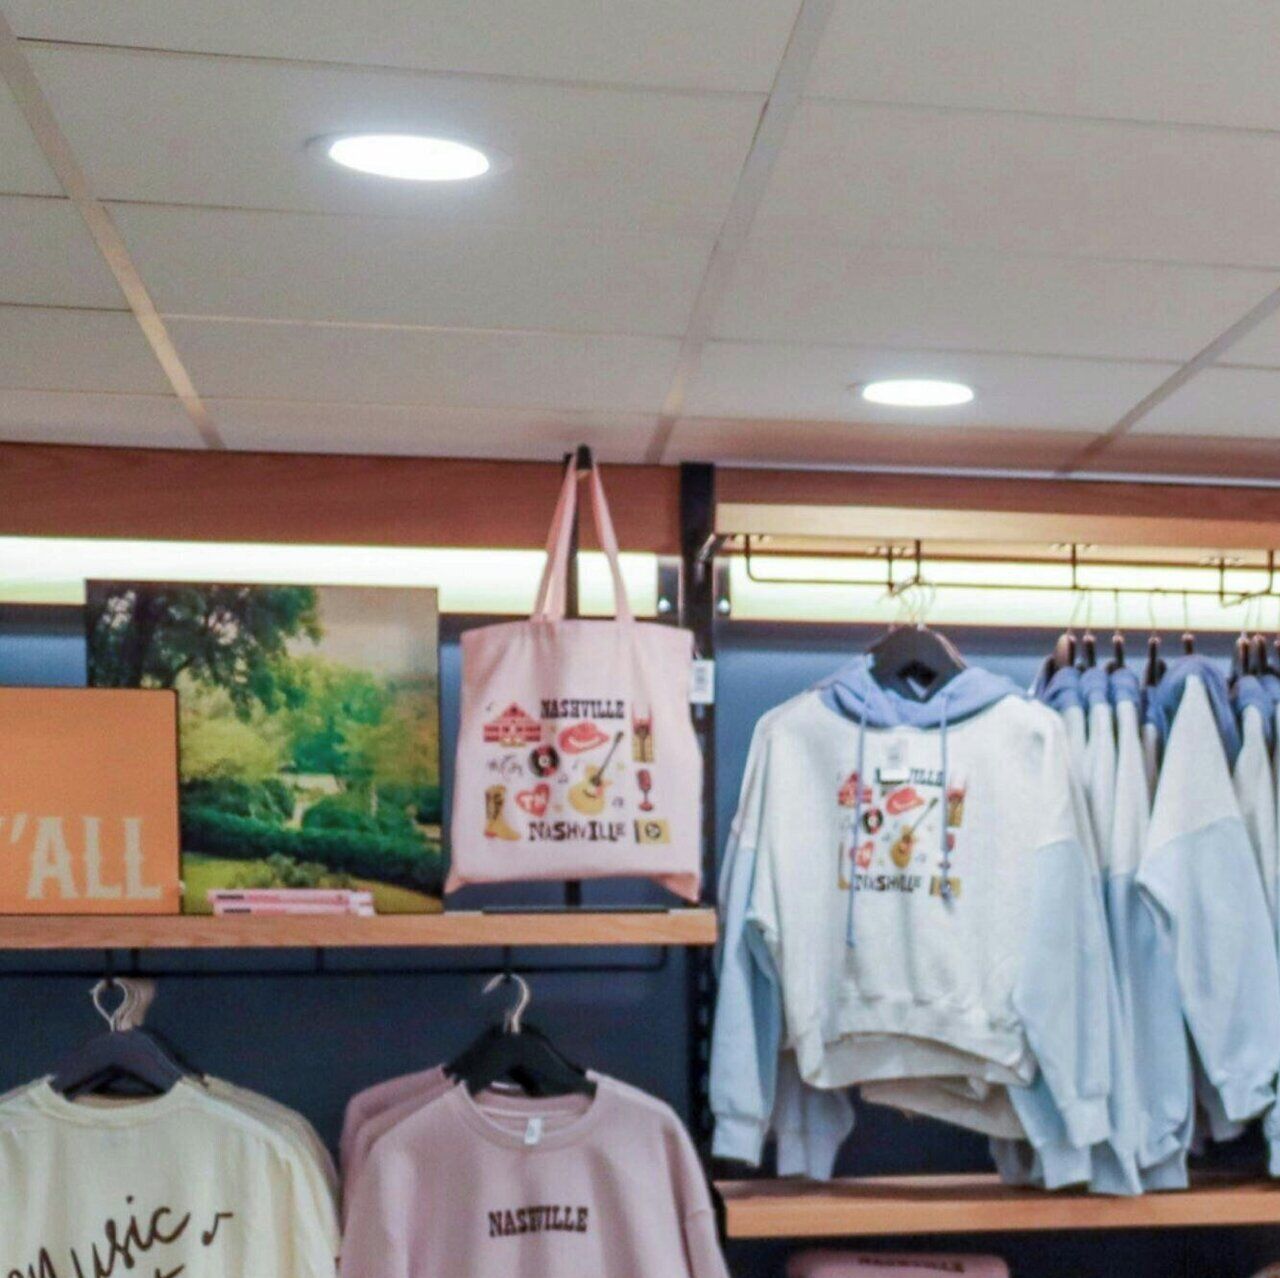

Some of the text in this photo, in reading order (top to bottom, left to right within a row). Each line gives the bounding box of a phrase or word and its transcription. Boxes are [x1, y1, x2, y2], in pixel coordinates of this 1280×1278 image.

[541, 700, 625, 719] NASHVILLE
[528, 820, 626, 841] NASHVILLE
[0, 811, 163, 899] 'ALL
